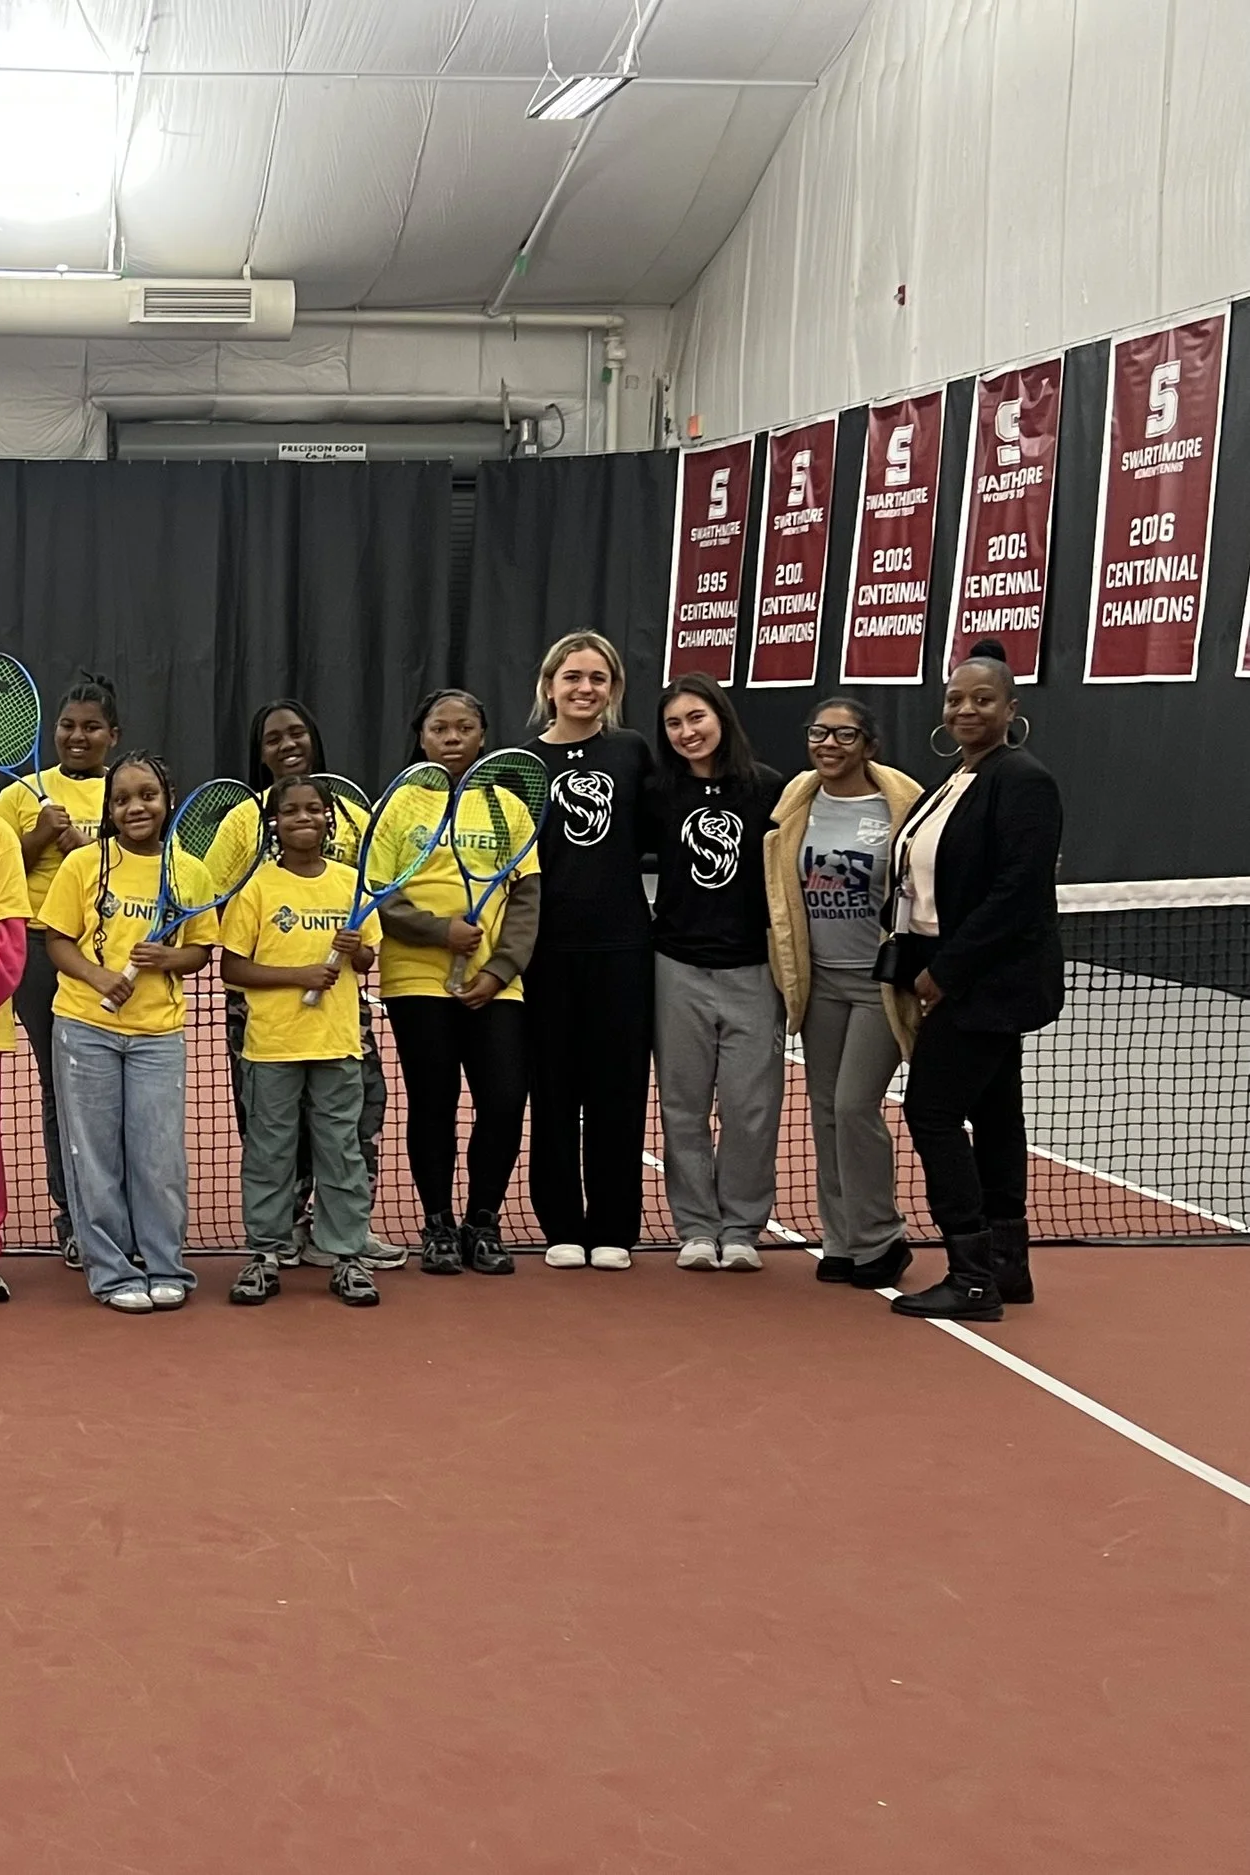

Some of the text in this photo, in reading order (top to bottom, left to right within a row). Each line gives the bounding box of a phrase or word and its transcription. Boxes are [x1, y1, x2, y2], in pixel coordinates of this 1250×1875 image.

[281, 444, 364, 453] PRECISION DOOR
[873, 547, 912, 573] 2003
[697, 571, 728, 593] 1995
[775, 563, 803, 586] 200
[301, 915, 348, 931] UNITE
